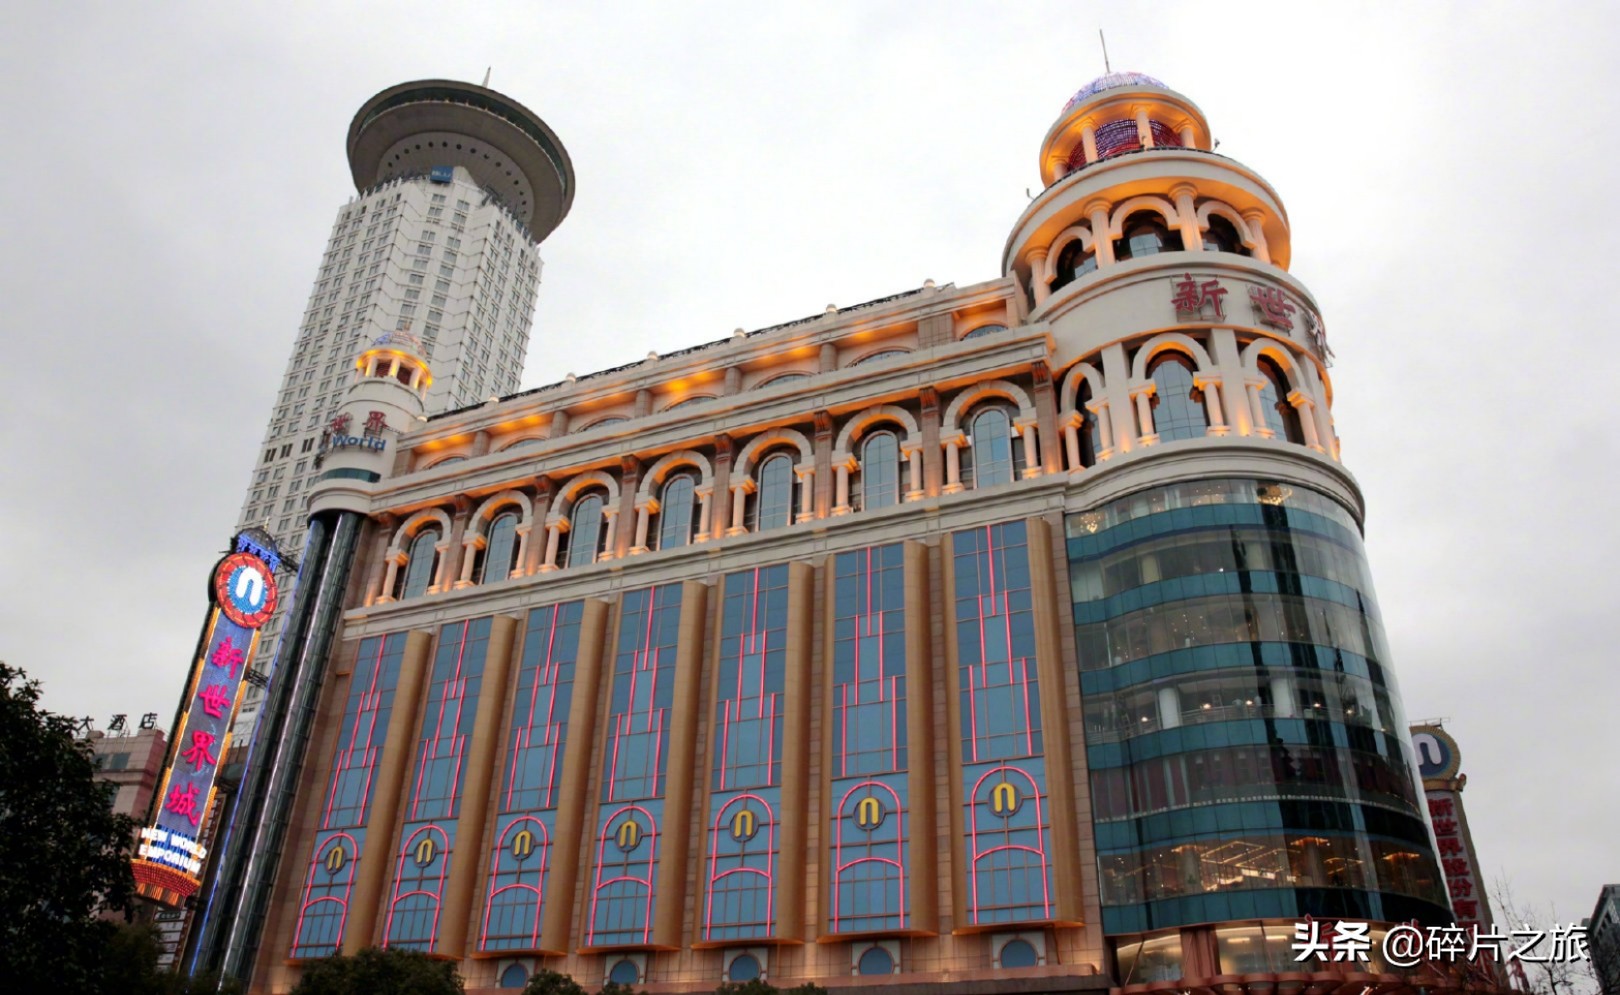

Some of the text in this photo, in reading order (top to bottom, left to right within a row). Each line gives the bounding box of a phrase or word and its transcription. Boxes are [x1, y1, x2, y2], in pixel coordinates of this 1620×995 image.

[165, 636, 243, 825] 新世界城
[138, 843, 202, 875] EMPORIUM
[141, 827, 207, 859] NEW WORLD
